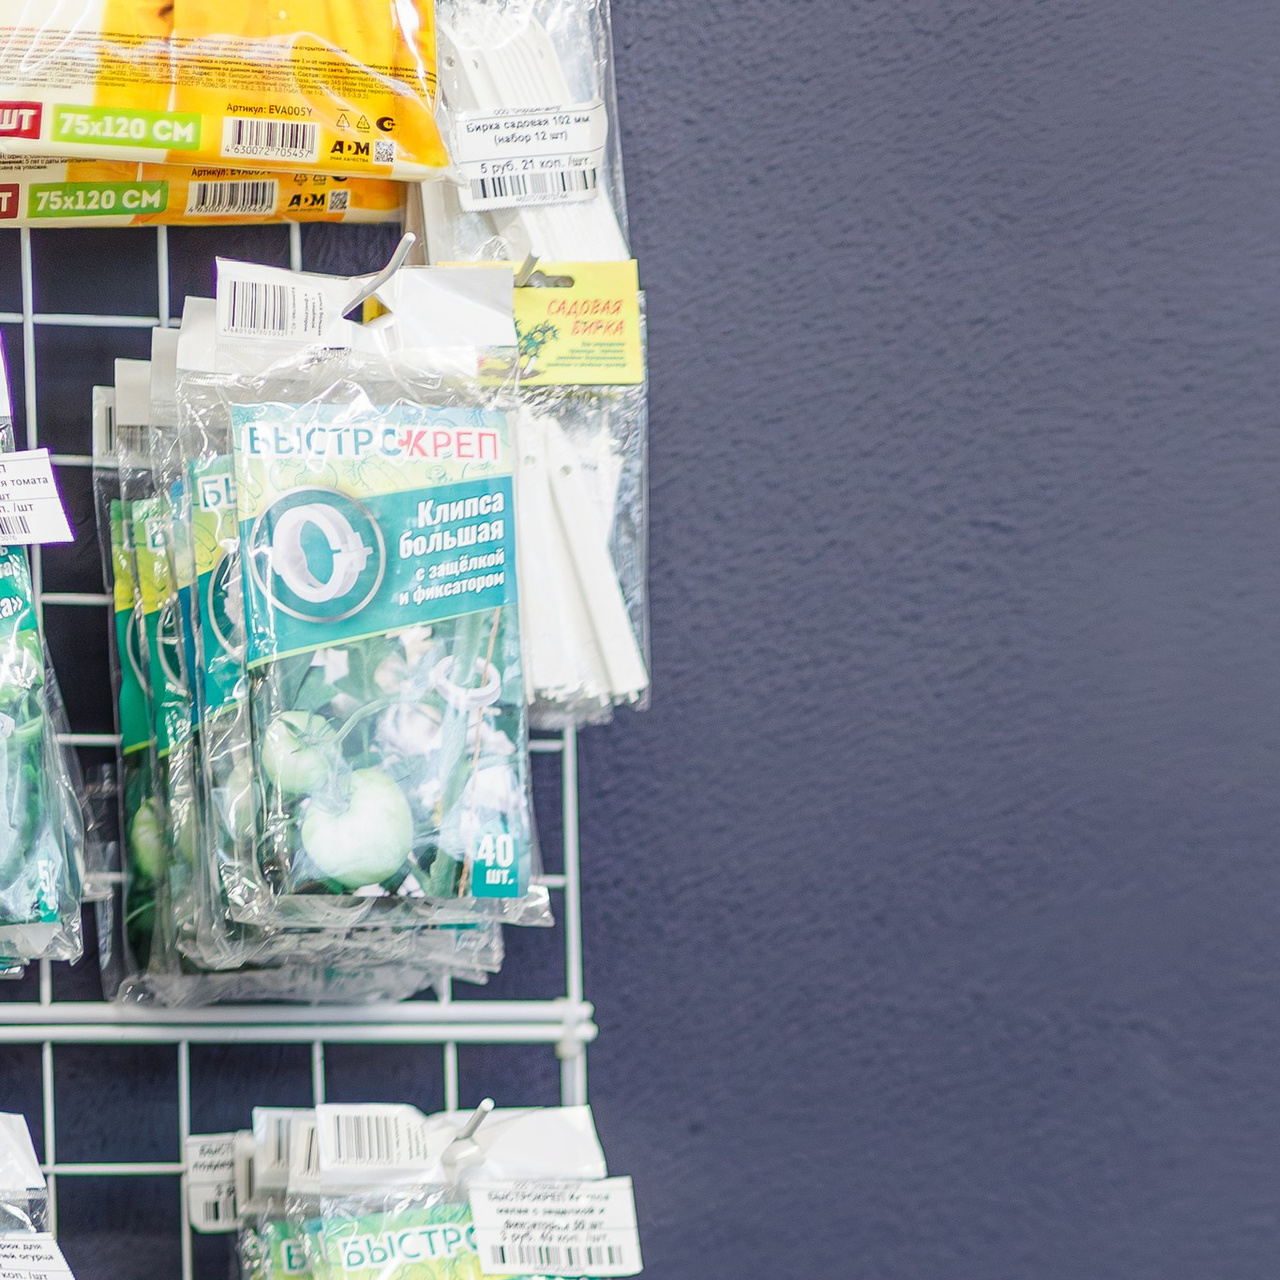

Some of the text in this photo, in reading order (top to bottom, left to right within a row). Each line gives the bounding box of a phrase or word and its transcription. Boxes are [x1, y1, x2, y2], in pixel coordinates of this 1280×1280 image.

[226, 102, 313, 116] Артикул: EVA005Y
[153, 119, 195, 143] СМ
[466, 121, 501, 133] Бирка
[504, 118, 549, 130] садовая
[553, 115, 571, 126] 102
[0, 191, 12, 212] Т
[123, 189, 161, 209] СМ
[547, 298, 624, 317] САДОВАЯ
[571, 318, 625, 336] БИРКА
[10, 475, 49, 486] томата
[418, 491, 505, 529] Клипса
[400, 520, 505, 560] большая
[416, 547, 505, 582] с защёлкой
[412, 572, 505, 606] фиксатором
[477, 833, 515, 868] 40
